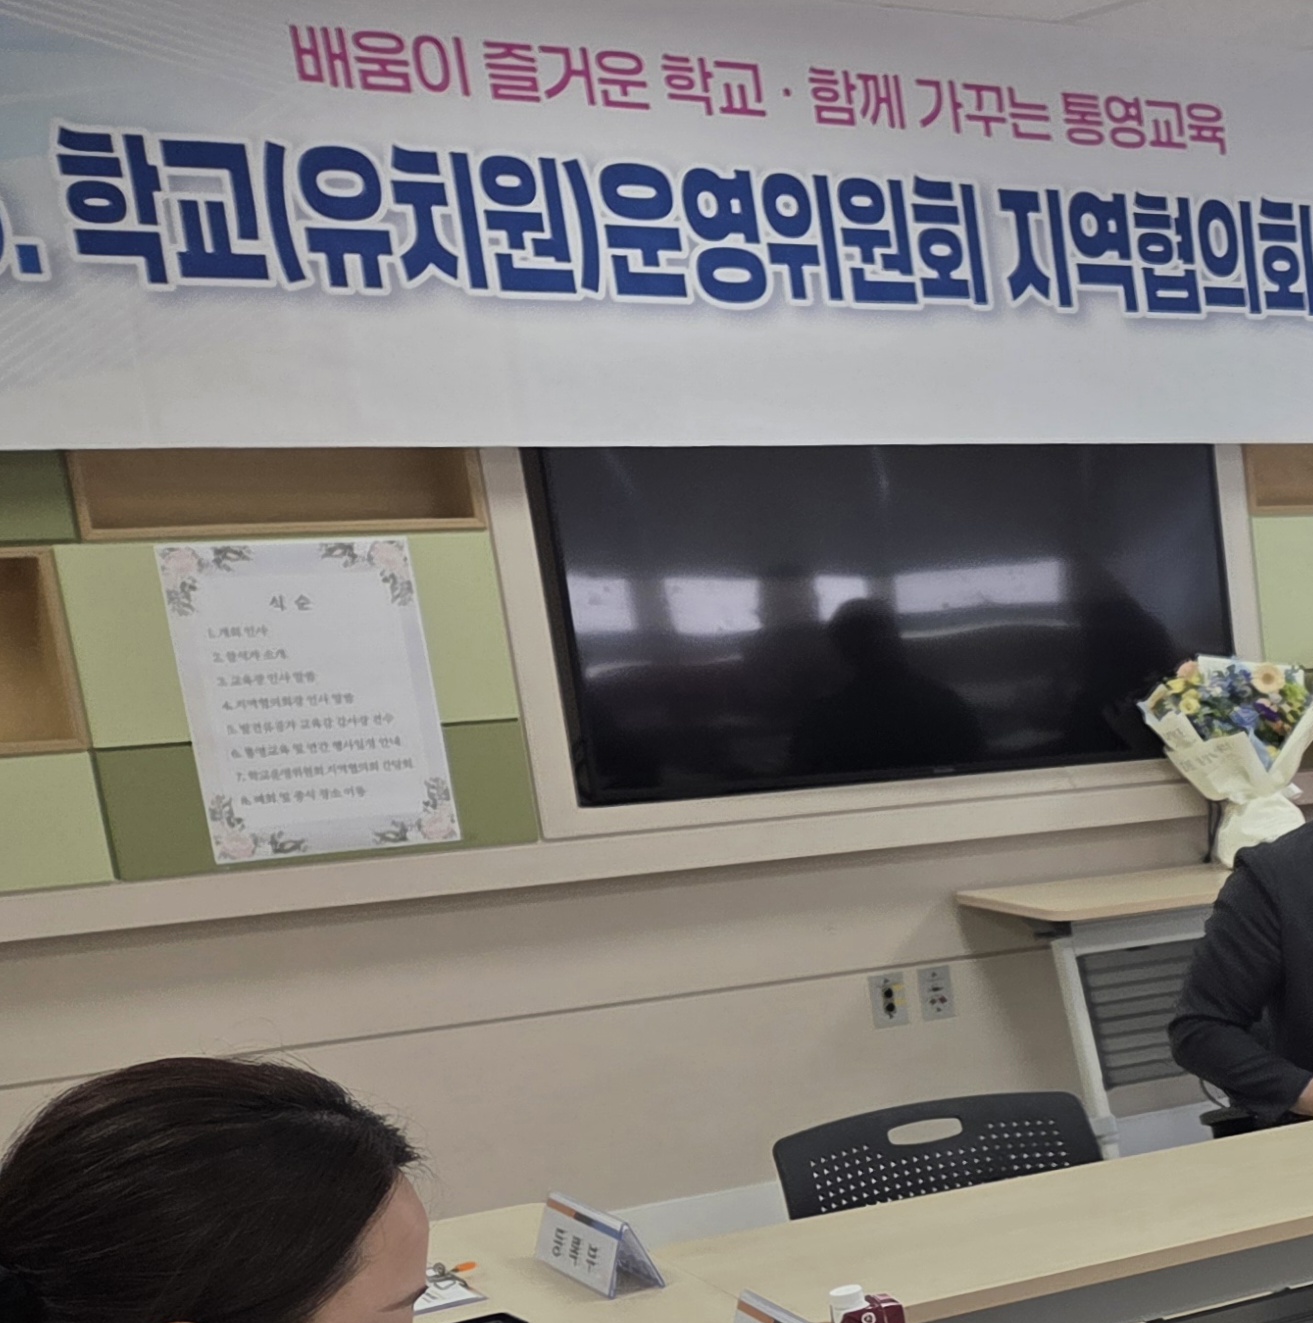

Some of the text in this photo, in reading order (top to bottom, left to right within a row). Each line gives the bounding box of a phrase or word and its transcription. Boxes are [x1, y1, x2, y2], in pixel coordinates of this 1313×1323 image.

[289, 25, 472, 98] 배움이
[483, 40, 652, 112] 즐거운
[662, 53, 768, 119] 학교
[807, 66, 907, 129] 함께
[915, 77, 1052, 143] 가꾸는
[1061, 89, 1228, 156] 통영교육
[57, 125, 989, 308] 학교(유치원)운영위원회
